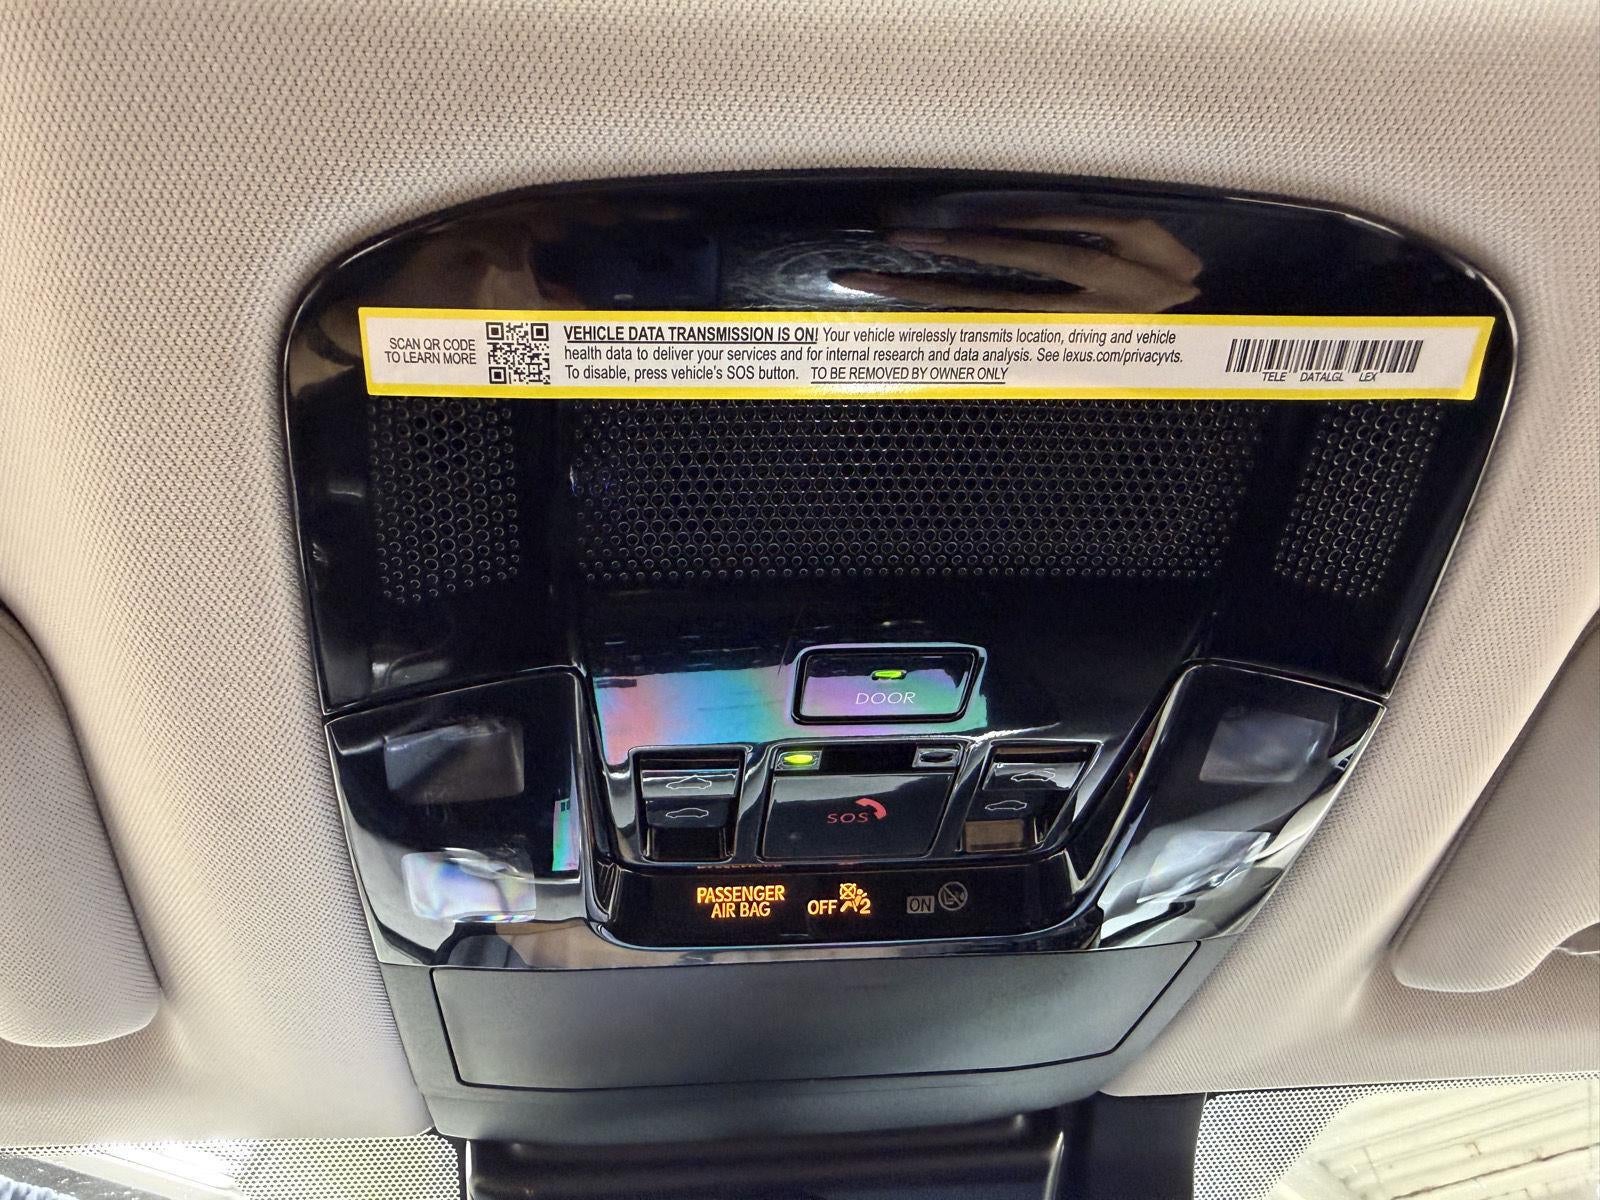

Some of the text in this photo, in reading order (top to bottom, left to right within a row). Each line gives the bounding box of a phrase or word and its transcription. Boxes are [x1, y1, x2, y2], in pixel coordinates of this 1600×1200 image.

[564, 325, 1176, 346] VEHICLE DATA TRANSMISSION IS ON! Your vehicle wirelessly transmits location, driving and vehicle
[389, 338, 476, 351] SCAN QR CODE
[384, 350, 477, 365] TO LEARN MORE
[564, 346, 1183, 366] health data to deliver your services and for internal research and data analysis. See lexus.com/privacyvts.
[565, 365, 1008, 382] To disable, press vehicle's SOS button. TO BE REMOVED BY OWNER ONLY
[1262, 372, 1288, 382] TELE
[1358, 372, 1379, 382] LEX
[855, 691, 917, 705] DOOR
[827, 812, 869, 824] SOS
[696, 885, 786, 904] PASSENGER
[711, 901, 771, 919] AIR BAG
[807, 899, 838, 915] OFF
[909, 898, 932, 912] ON
